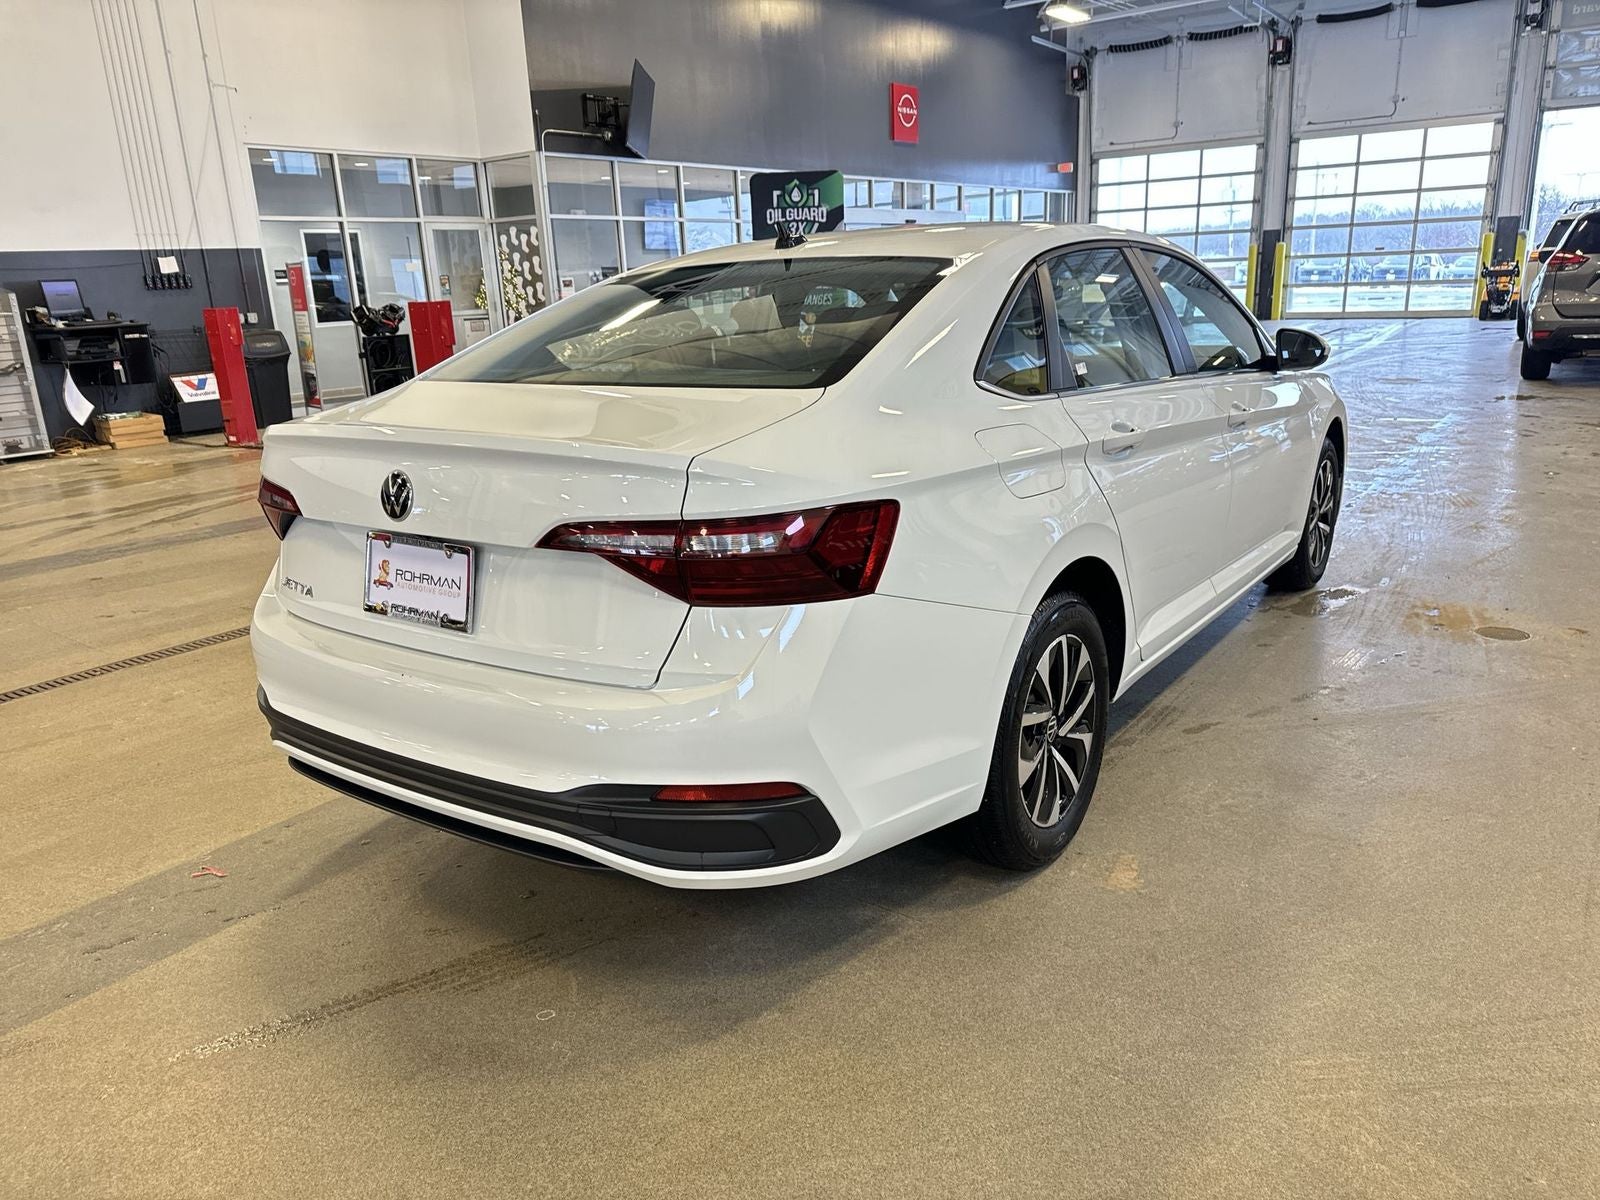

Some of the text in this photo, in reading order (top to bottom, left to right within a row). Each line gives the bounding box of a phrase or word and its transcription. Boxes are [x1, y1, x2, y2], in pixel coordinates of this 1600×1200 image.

[395, 568, 462, 591] ROHRMAN
[397, 581, 461, 598] AUTOMOTIVE GROUP
[391, 603, 440, 620] ROHRMAN
